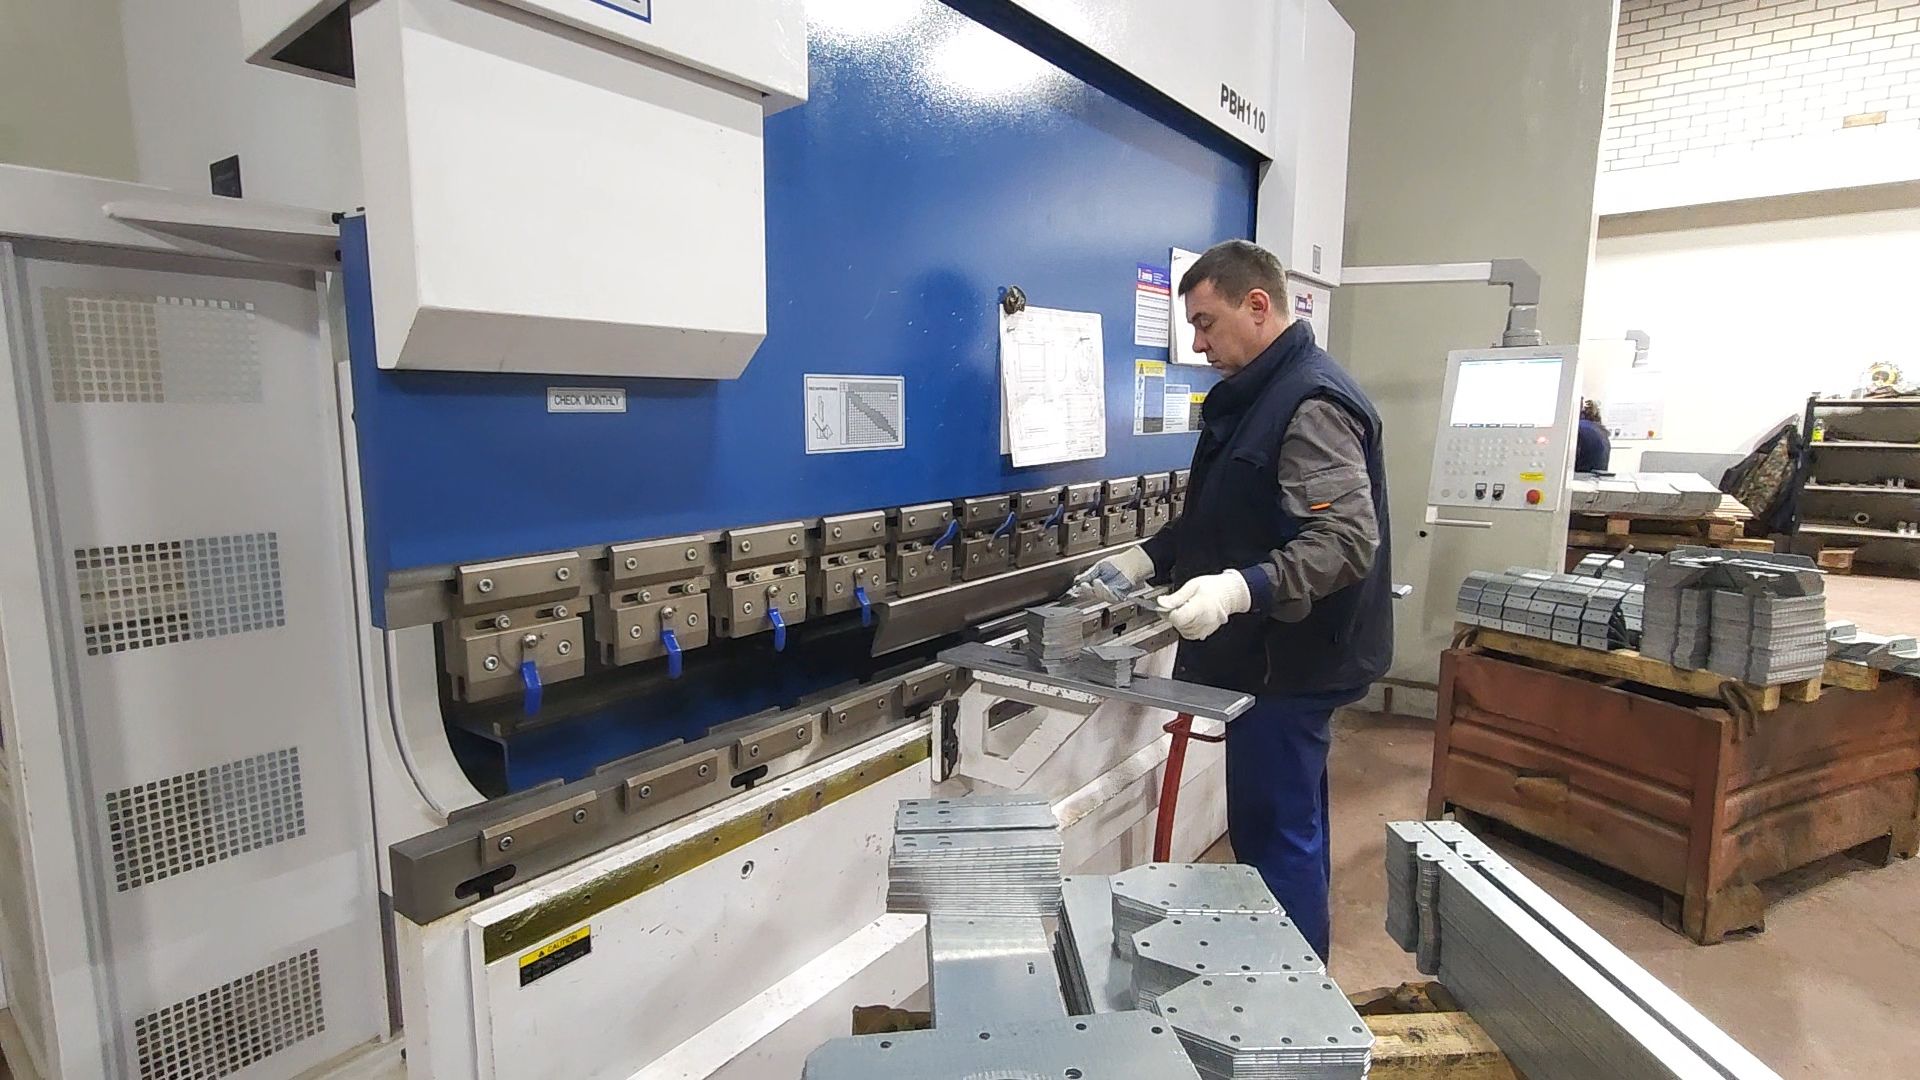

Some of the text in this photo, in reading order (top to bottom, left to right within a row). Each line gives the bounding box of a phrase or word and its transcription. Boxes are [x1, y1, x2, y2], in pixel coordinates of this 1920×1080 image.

[1221, 82, 1266, 134] PBH110
[554, 394, 620, 406] CHECK MONTHLY
[547, 934, 578, 953] CAUTION
